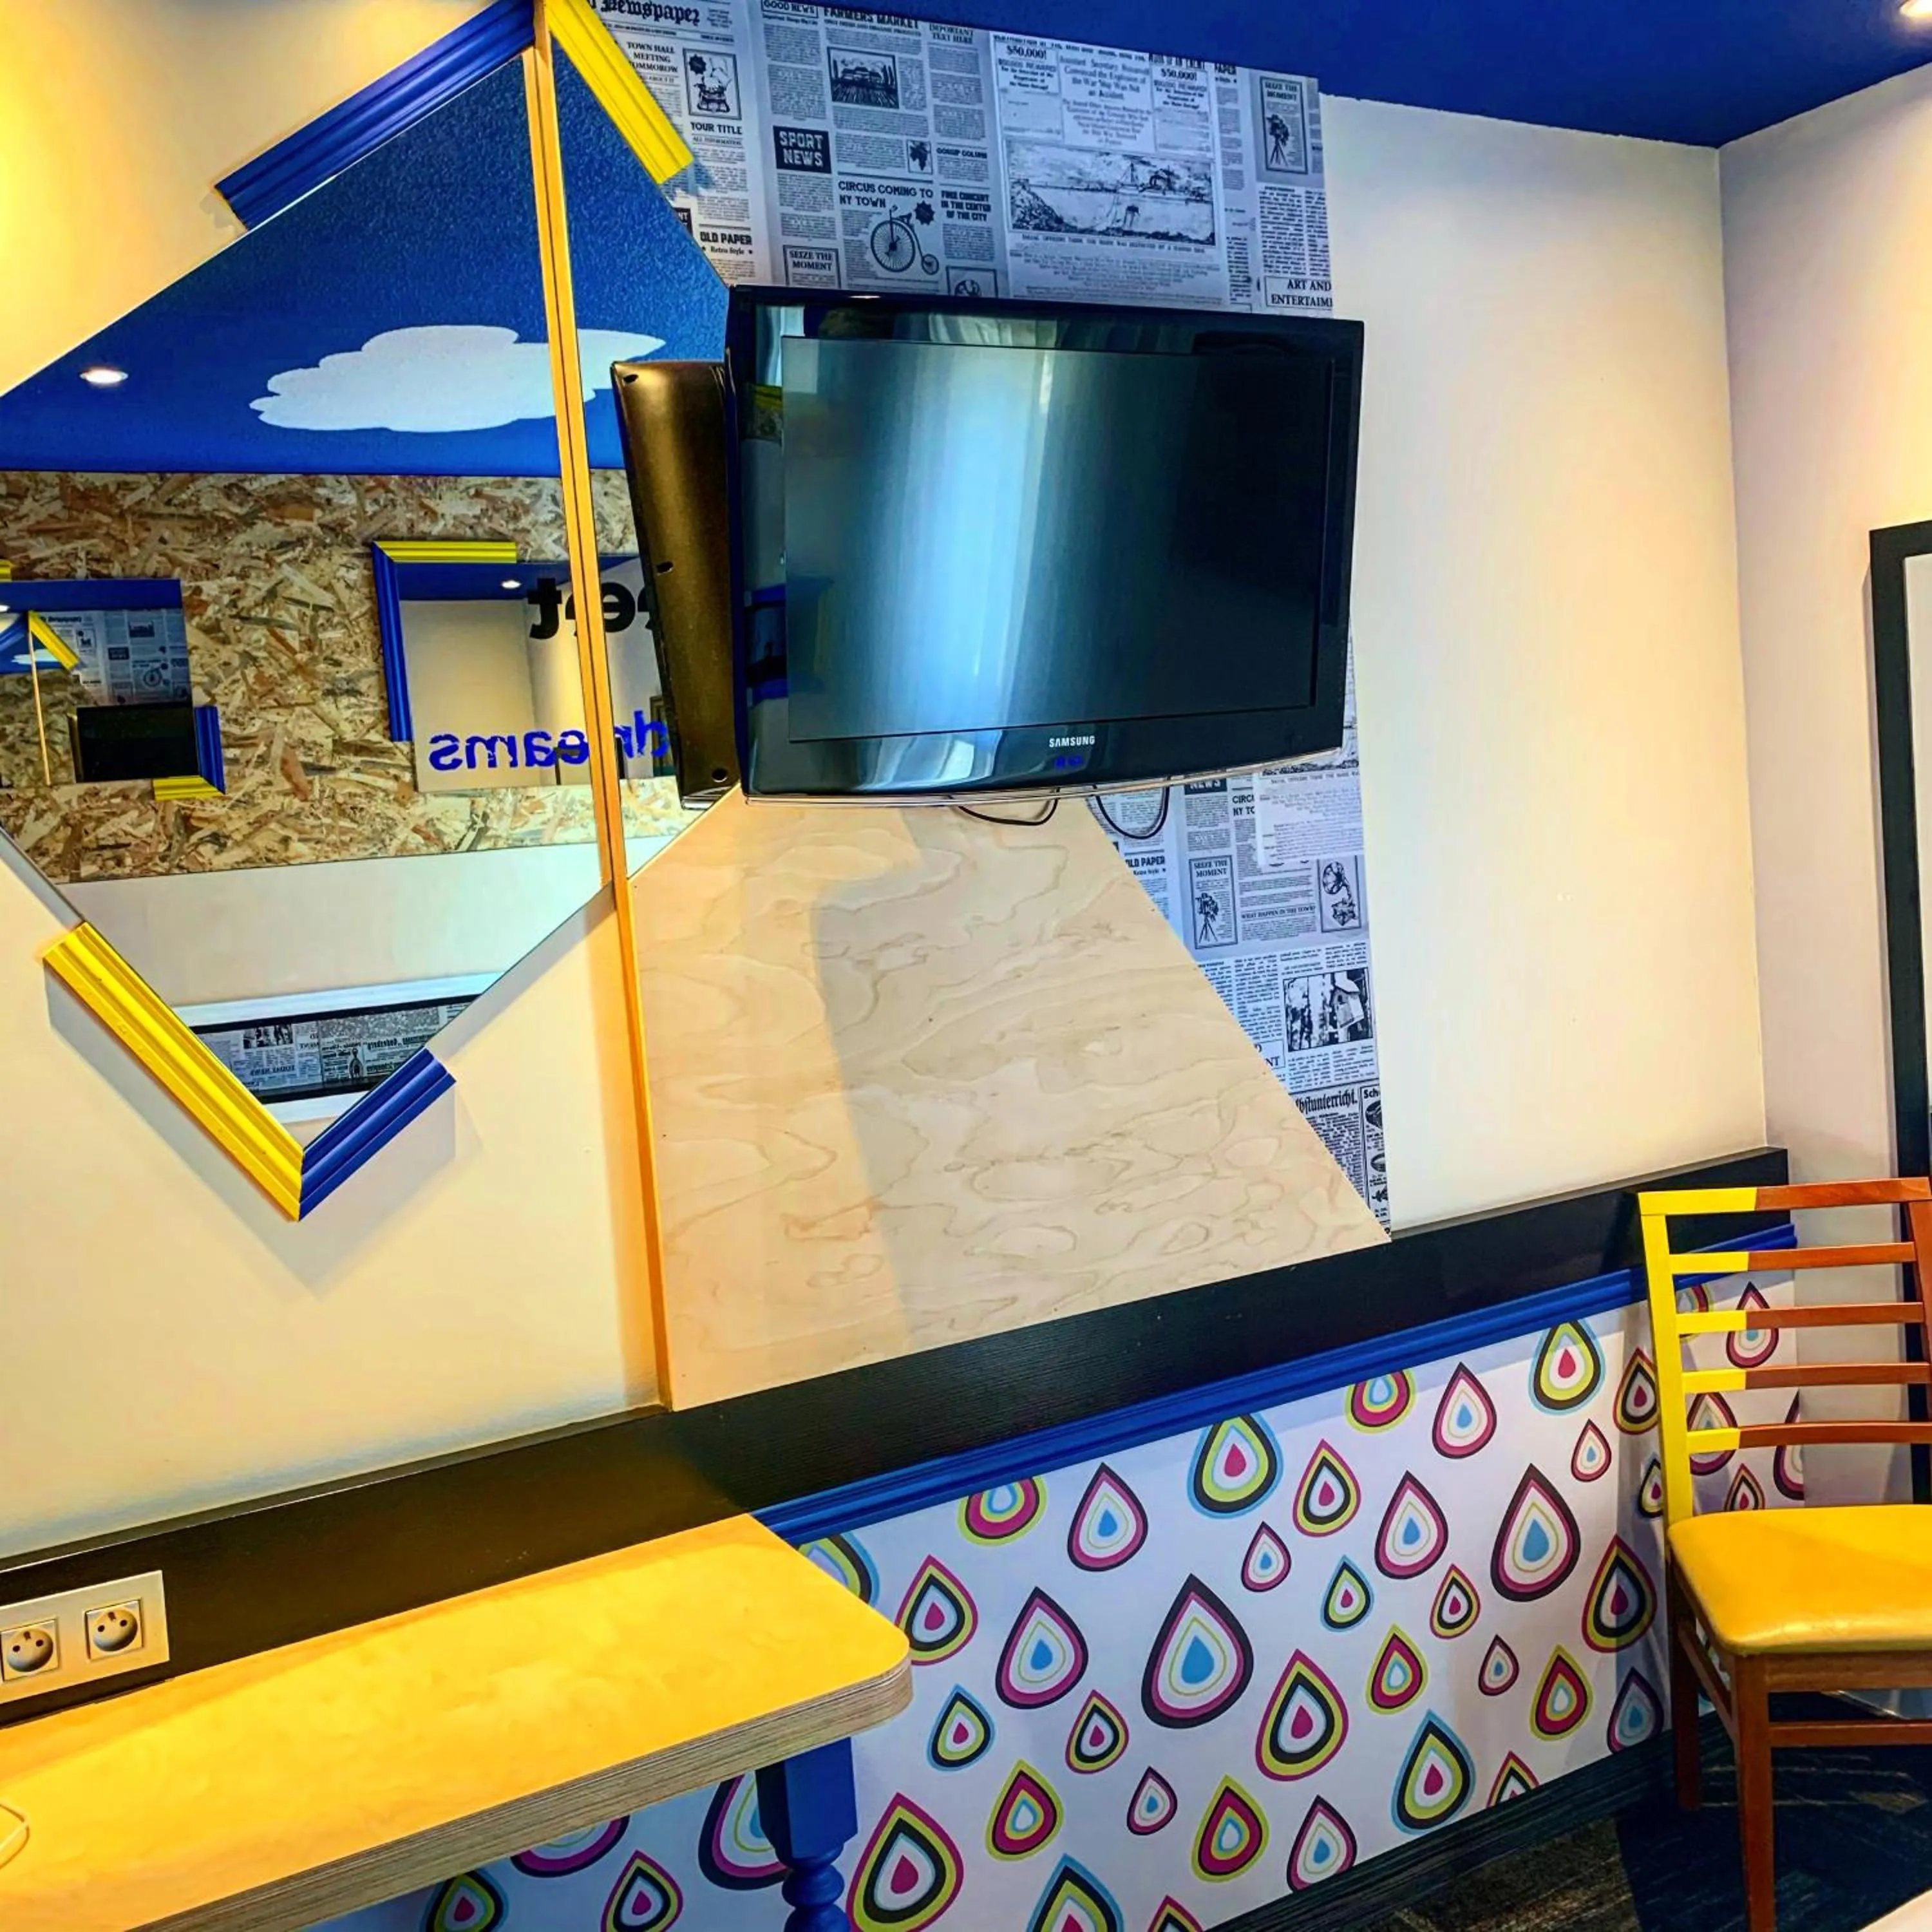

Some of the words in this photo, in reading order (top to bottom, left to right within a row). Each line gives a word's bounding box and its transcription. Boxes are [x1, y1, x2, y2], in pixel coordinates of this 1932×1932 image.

[600, 0, 700, 26] Newspaper
[627, 41, 652, 52] TOWN
[654, 44, 676, 54] HALL
[634, 52, 671, 63] MEETING
[690, 122, 715, 133] YOUR
[717, 124, 743, 135] TITLE
[779, 131, 824, 149] SPORT
[783, 148, 823, 167] NEWS
[838, 180, 875, 193] CIRCUS
[878, 184, 917, 197] COMING
[919, 188, 933, 198] TO
[857, 197, 886, 208] TOWN
[700, 230, 719, 243] OLD
[721, 232, 753, 245] PAPER
[790, 251, 815, 260] SEIZE
[815, 252, 834, 261] THE
[792, 260, 833, 271] MOMENT
[1287, 278, 1307, 289] ART
[1309, 279, 1331, 292] AND
[1048, 735, 1095, 748] SAMSUNG
[1141, 856, 1166, 866] PAPER
[1194, 860, 1213, 869] SEIZE
[1196, 868, 1227, 877] MOMENT
